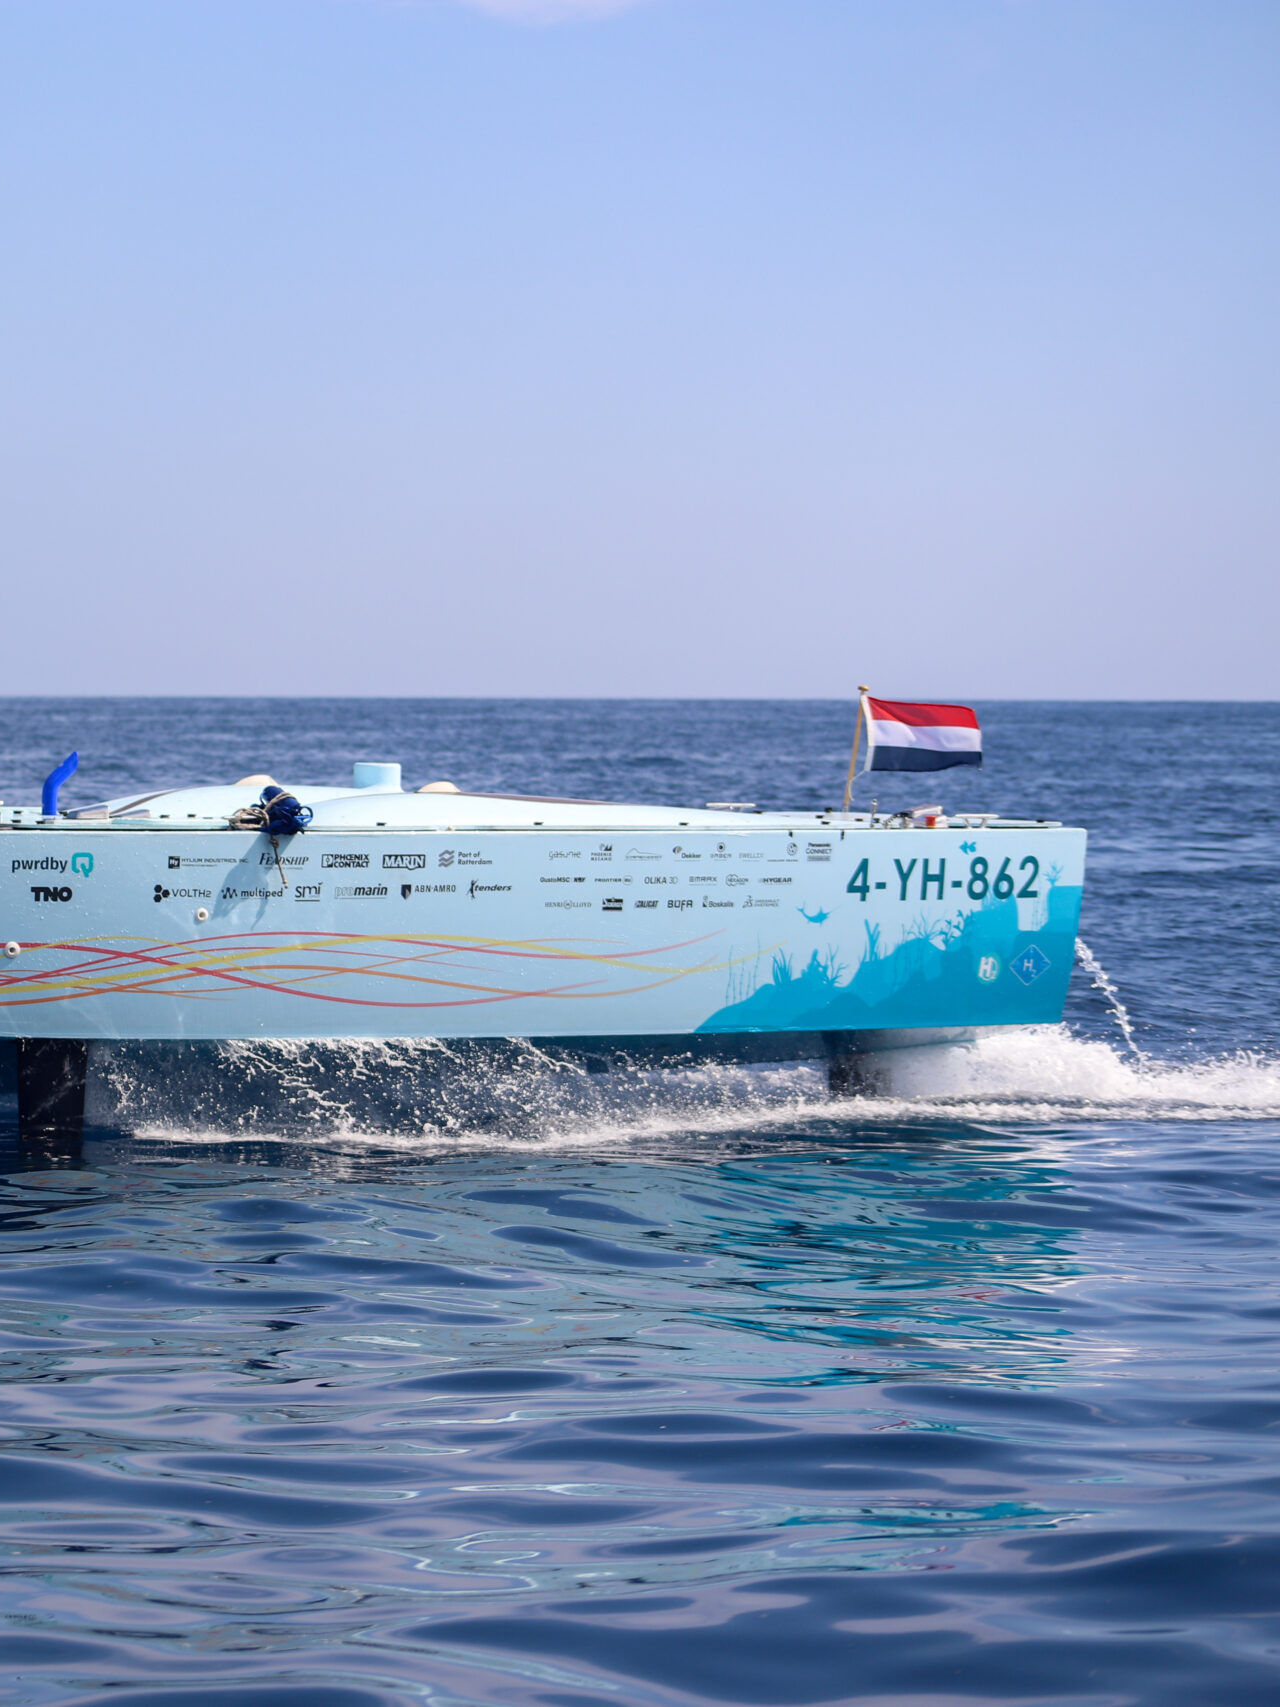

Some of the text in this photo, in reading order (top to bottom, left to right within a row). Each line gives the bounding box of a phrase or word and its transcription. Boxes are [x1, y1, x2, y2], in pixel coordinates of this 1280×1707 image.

[11, 856, 68, 873] pwrdby
[383, 855, 425, 868] MARIN
[846, 855, 1040, 901] 4-YH-862
[31, 886, 73, 902] TNO
[172, 889, 212, 898] VOLTH2
[241, 886, 283, 899] multiped
